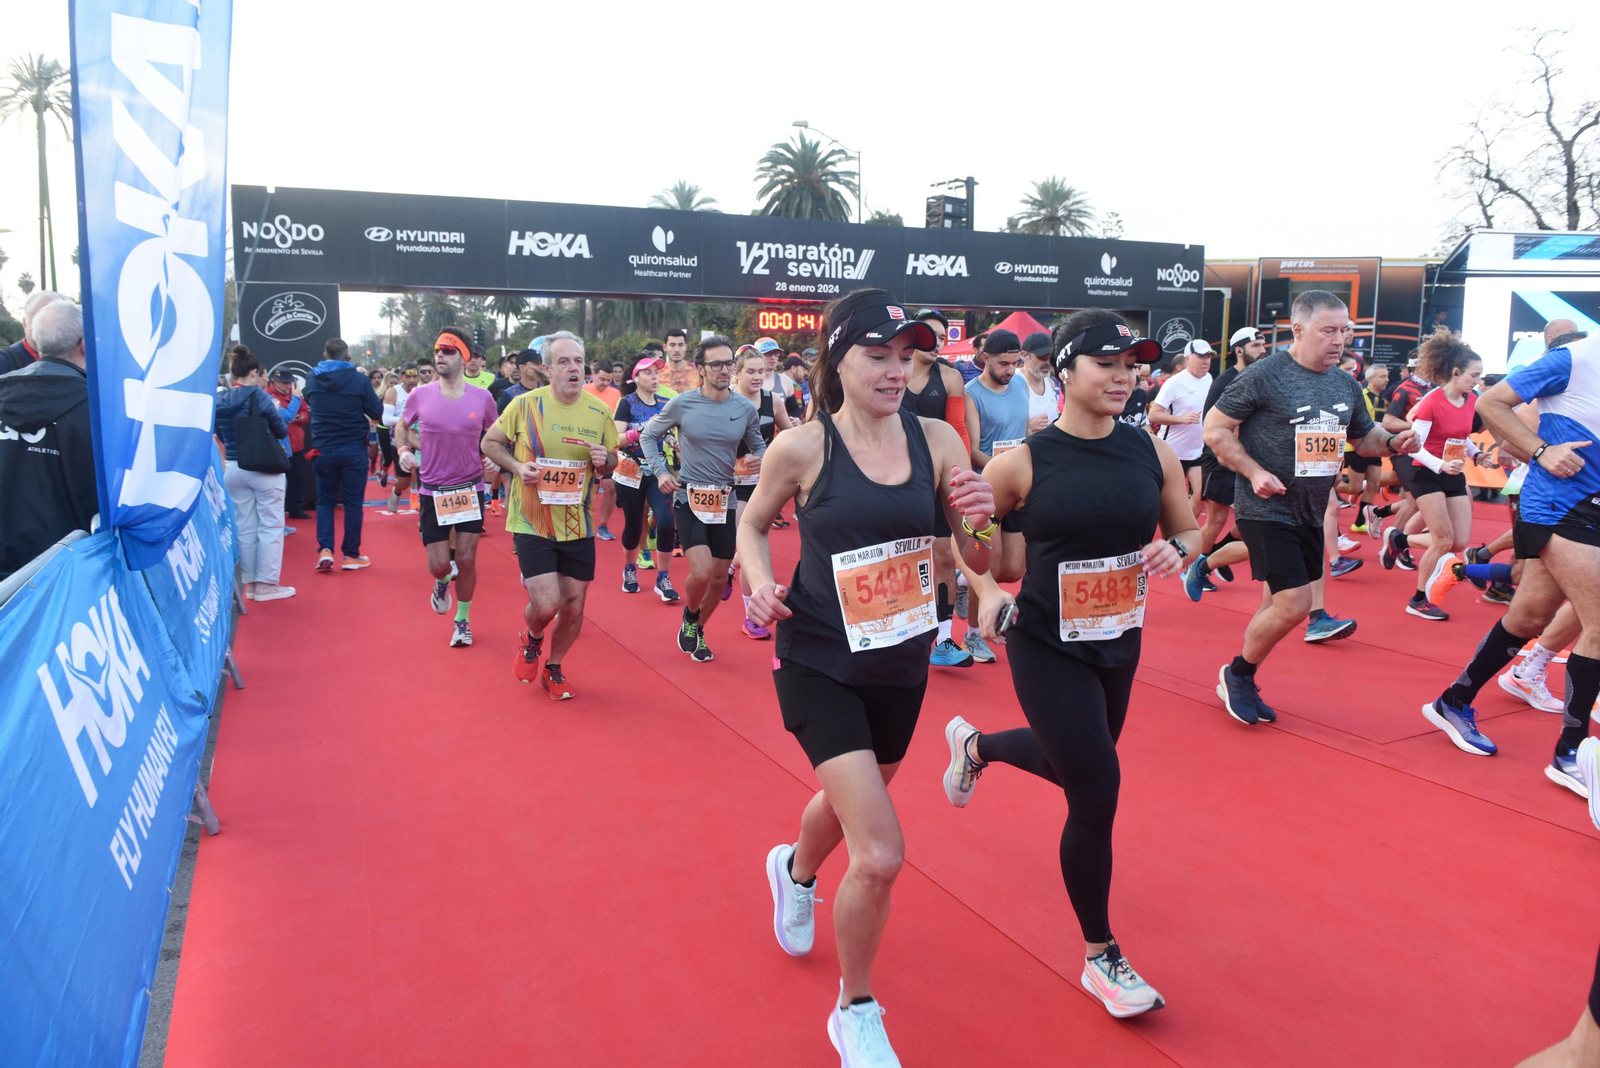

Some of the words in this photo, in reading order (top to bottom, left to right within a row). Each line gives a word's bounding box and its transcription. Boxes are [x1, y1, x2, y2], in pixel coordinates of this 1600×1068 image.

[396, 229, 465, 244] HYUNDAI
[507, 230, 592, 258] HOKA
[396, 243, 440, 253] Hyundauto
[441, 246, 465, 254] Motor
[762, 242, 855, 263] maratón
[111, 12, 215, 512] HOKA
[628, 254, 698, 267] quirónsalud
[906, 253, 969, 277] HOKA
[634, 269, 668, 278] Healthcare
[669, 270, 692, 279] Partner
[787, 259, 856, 280] sevilla
[1014, 263, 1059, 275] HYUNDAI
[775, 282, 787, 292] 28
[788, 284, 816, 293] enero
[817, 284, 840, 294] 2024
[1084, 276, 1133, 288] quirónsalud
[578, 427, 598, 436] Lisboa
[1305, 437, 1336, 453] 5129
[543, 470, 576, 486] 4479
[441, 495, 468, 509] 4140
[694, 492, 719, 506] 5281
[840, 555, 857, 566] MEDIO
[857, 546, 884, 561] MARATÓN
[894, 538, 922, 555] SEVILLA
[1065, 562, 1081, 571] MEDIO
[1081, 560, 1105, 570] MARATÓN
[1116, 552, 1137, 568] SEVILLA
[855, 562, 915, 605] 5482
[1075, 575, 1132, 605] 5483
[896, 629, 908, 638] HOKA
[36, 584, 151, 809] HOKA
[109, 806, 142, 891] FLY
[127, 728, 173, 840] HUMAN
[155, 702, 179, 756] FLY
